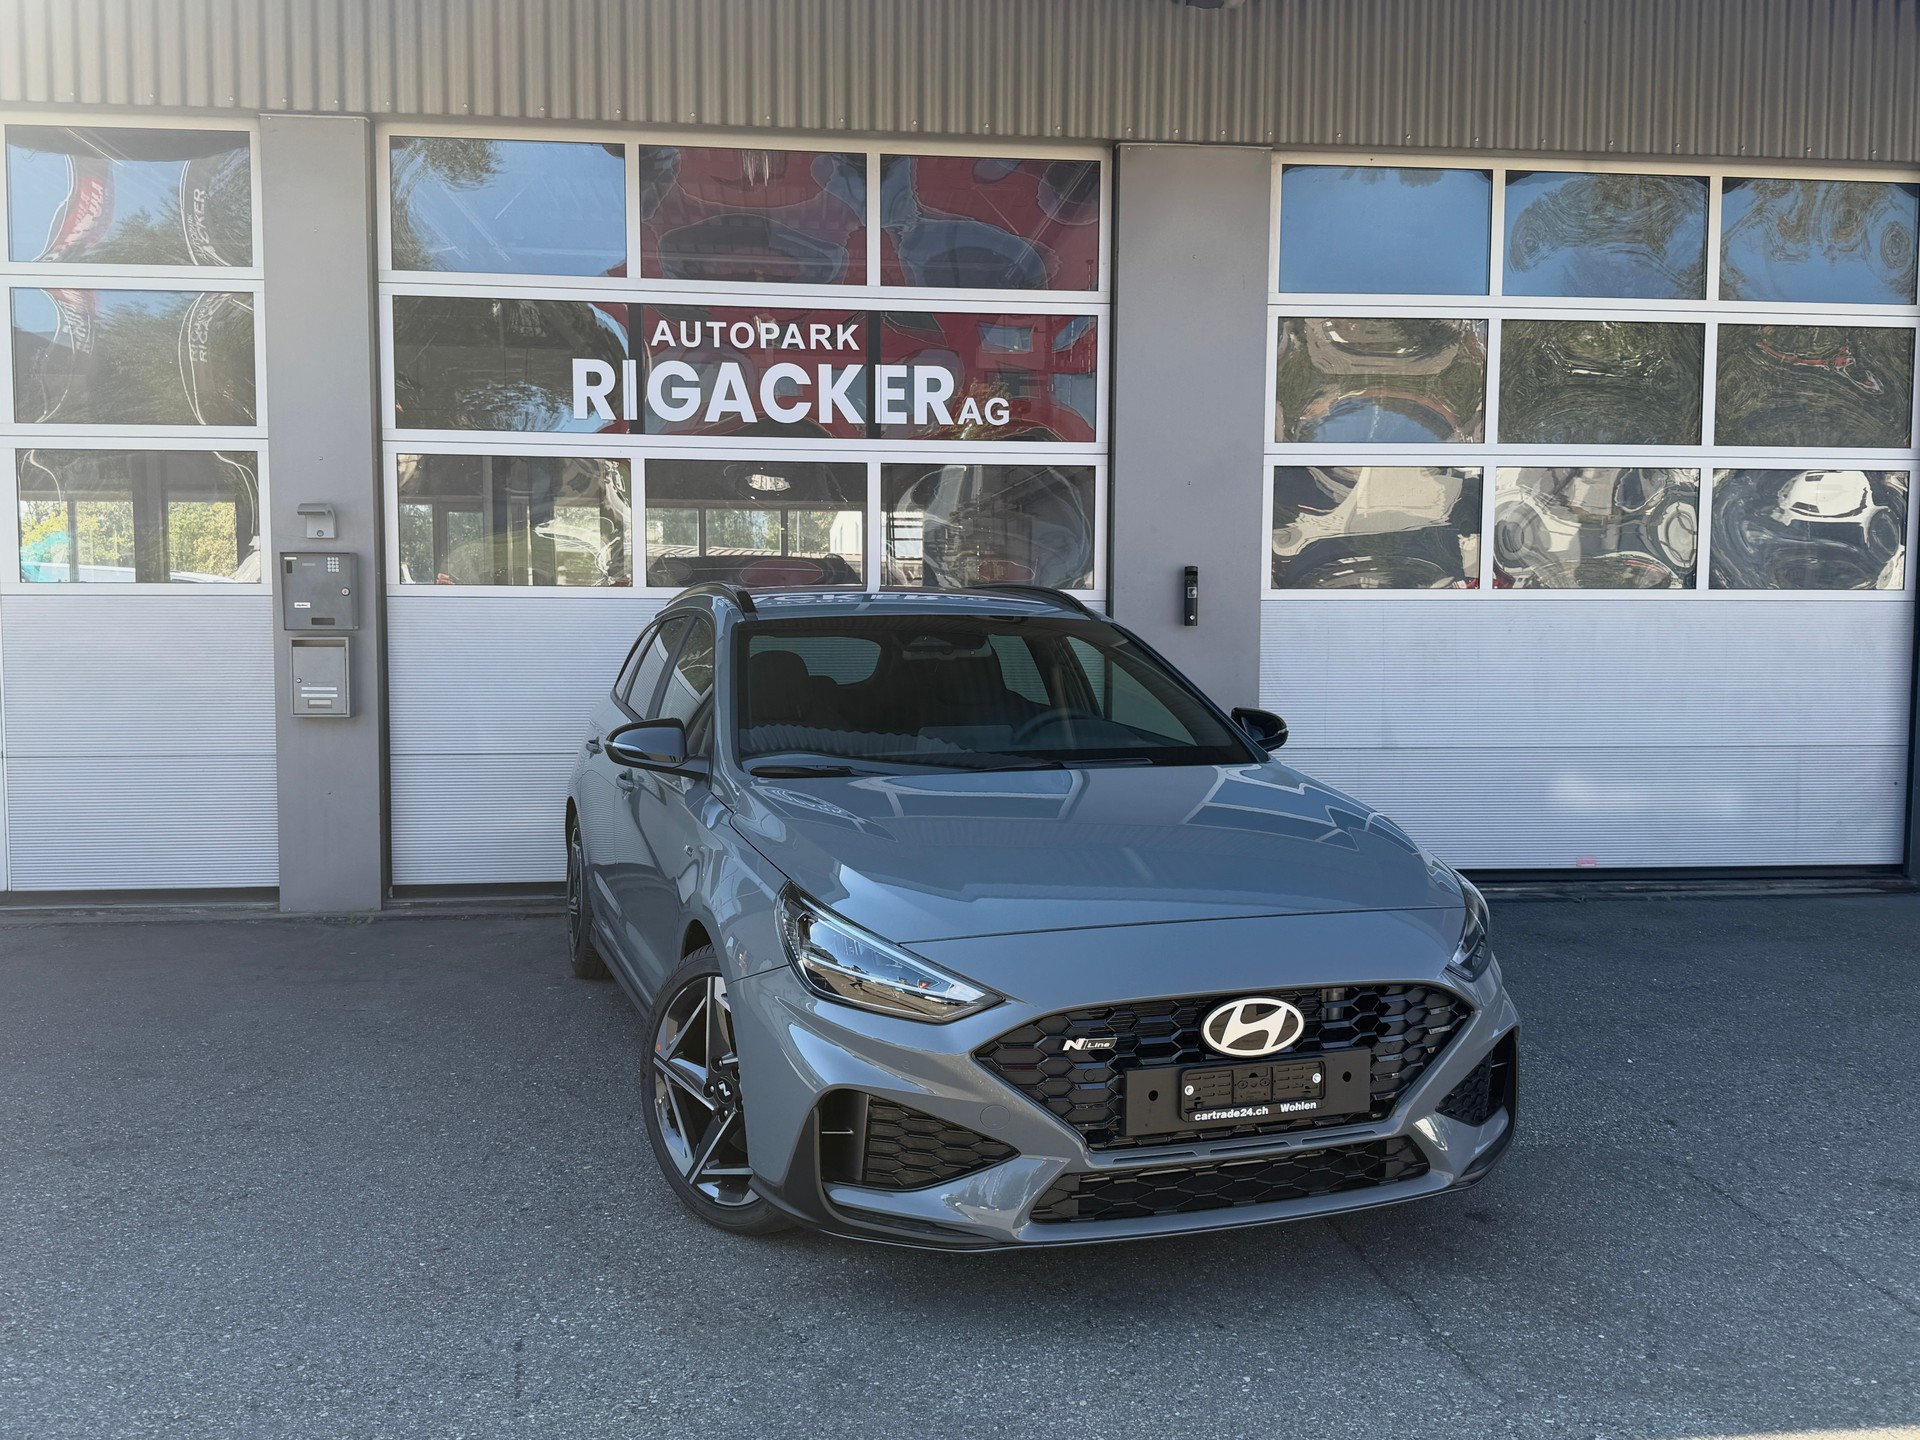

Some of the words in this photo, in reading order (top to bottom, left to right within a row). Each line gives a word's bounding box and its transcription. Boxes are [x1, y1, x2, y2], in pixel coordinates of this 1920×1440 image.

[651, 320, 860, 350] AUTOPARK
[572, 358, 955, 425] RIGACKER
[957, 397, 1011, 426] AG
[1062, 1038, 1086, 1051] N
[1194, 1106, 1269, 1121] cartrade24.ch
[1280, 1101, 1317, 1113] Wohlen
